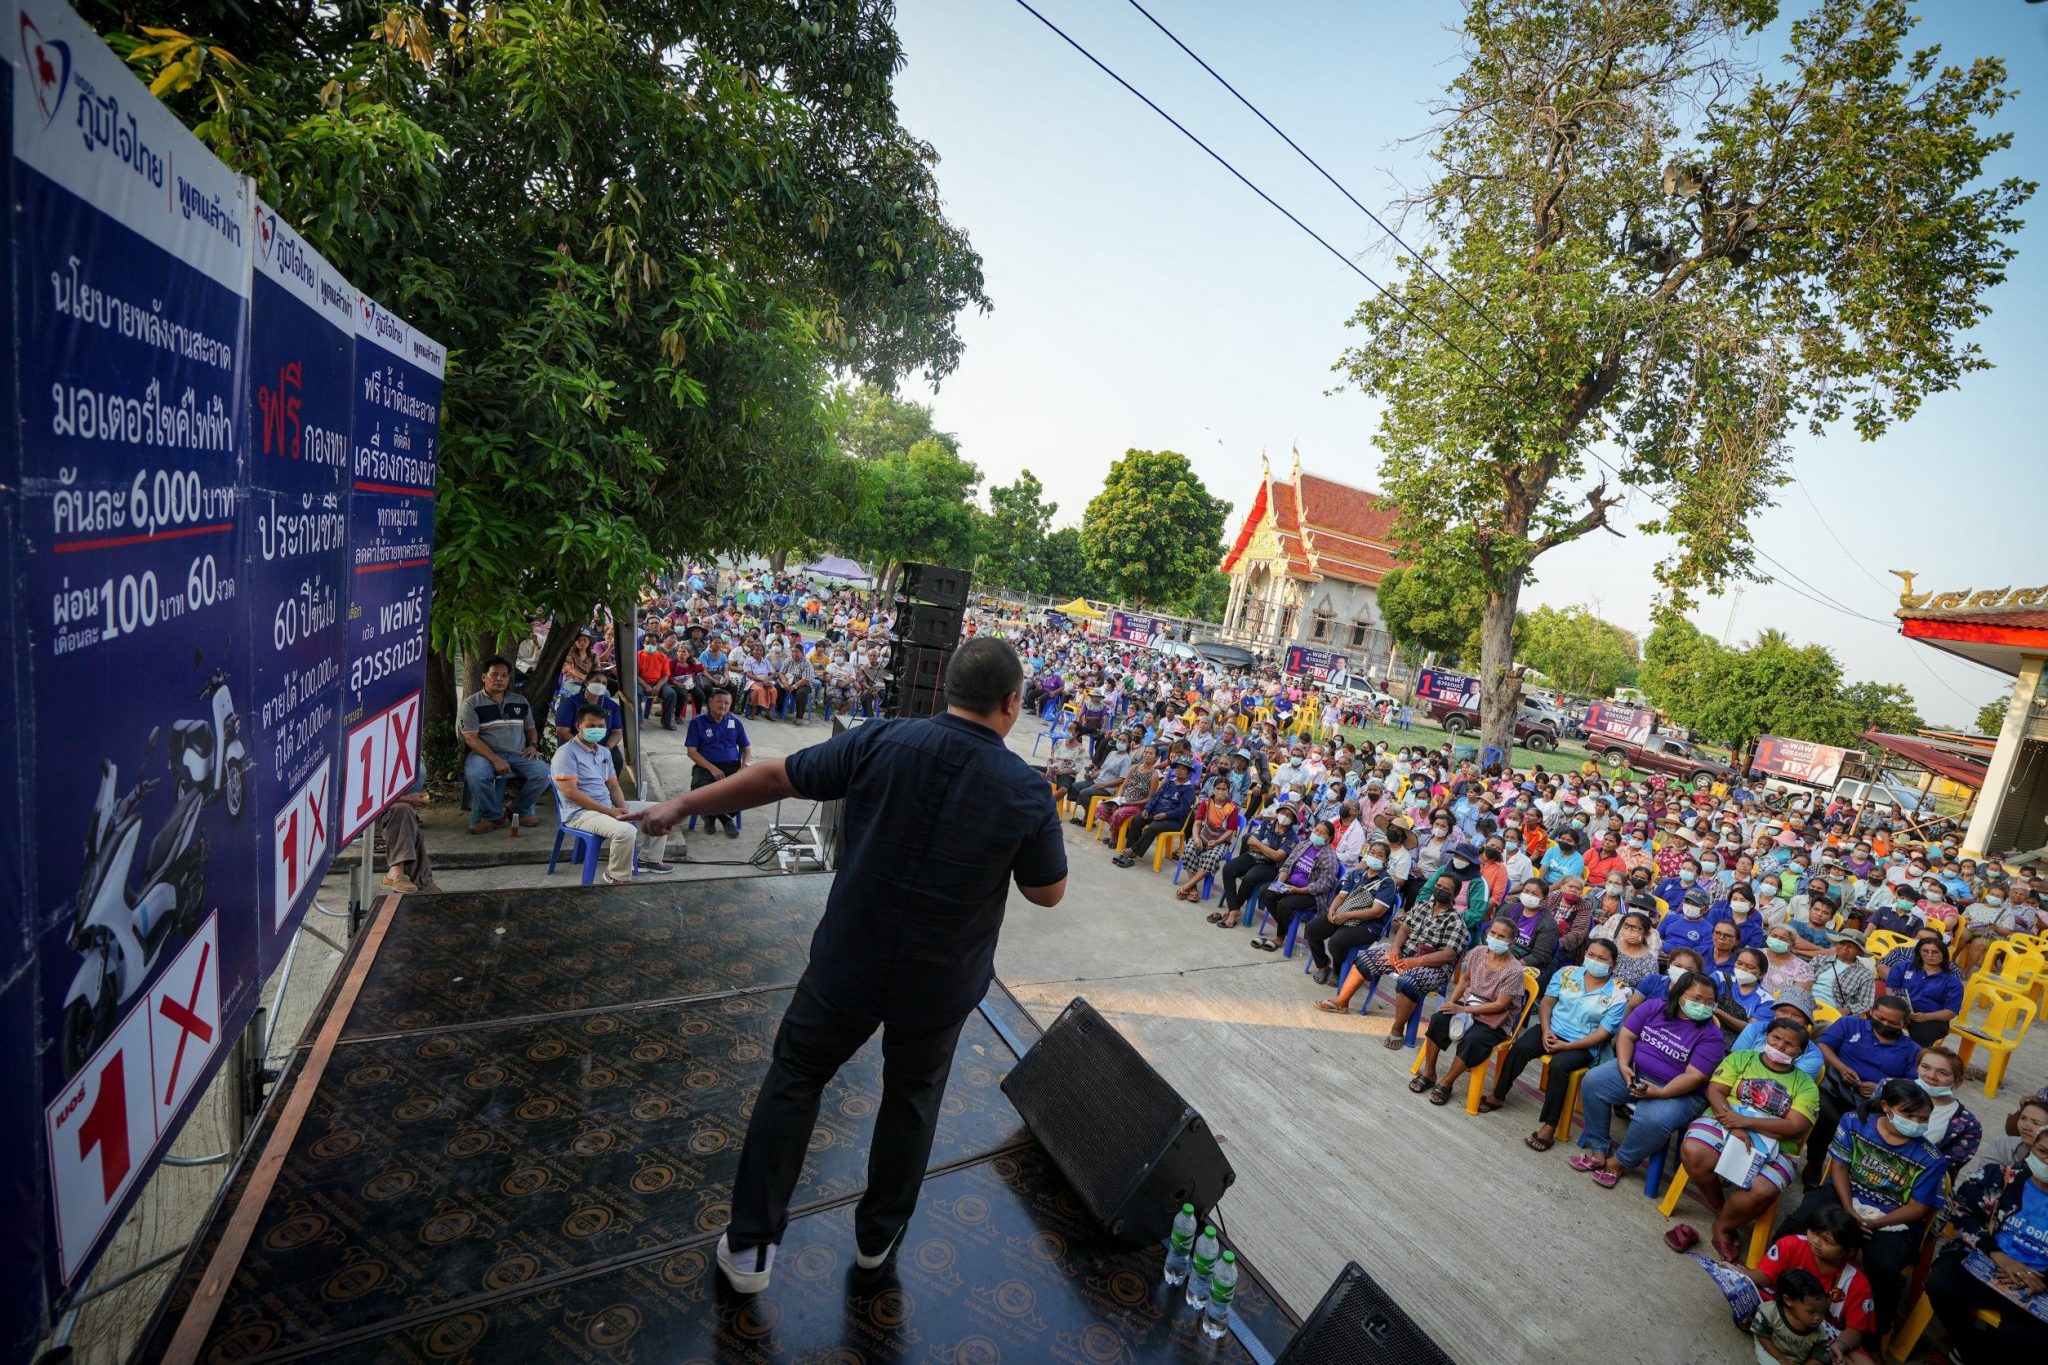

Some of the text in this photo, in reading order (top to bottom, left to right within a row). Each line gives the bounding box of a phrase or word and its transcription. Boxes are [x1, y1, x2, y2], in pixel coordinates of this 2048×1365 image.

[77, 91, 163, 189] ภูมิใจไทย
[277, 239, 315, 289] ภูมิใจไทย
[51, 255, 231, 372] นโยบายพลังงานสะอาด
[375, 314, 403, 345] ภูมิใจไทย
[52, 376, 233, 452] มอเตอร์ไซค์ไฟฟ้า
[258, 360, 303, 460] ฟรี
[364, 370, 381, 404] ฟรี
[305, 424, 347, 485] กองทุน
[354, 422, 437, 487] เครื่องกรองน้ำ
[54, 467, 235, 538] คันละ 6,000 บาท
[258, 492, 345, 561] ประกันชีวิต
[53, 554, 235, 641] ผ่อน 100 บาท 60 งวด
[273, 574, 337, 651] 60 ปีขึ้นไป
[380, 585, 425, 635] พลพีร์
[53, 625, 99, 657] เดือนละ
[350, 623, 424, 702] สุวรรณฉวี
[1290, 651, 1301, 670] 1
[262, 669, 298, 730] ตายได้
[300, 656, 332, 703] 100,000
[1420, 674, 1432, 694] 1
[1587, 705, 1601, 725] 1
[296, 703, 324, 752] 20,000
[1758, 742, 1774, 763] 1
[356, 735, 373, 821] 1
[282, 808, 298, 902] 1
[1640, 1030, 1689, 1062] สุวรรณฉวี
[78, 1048, 131, 1205] 1
